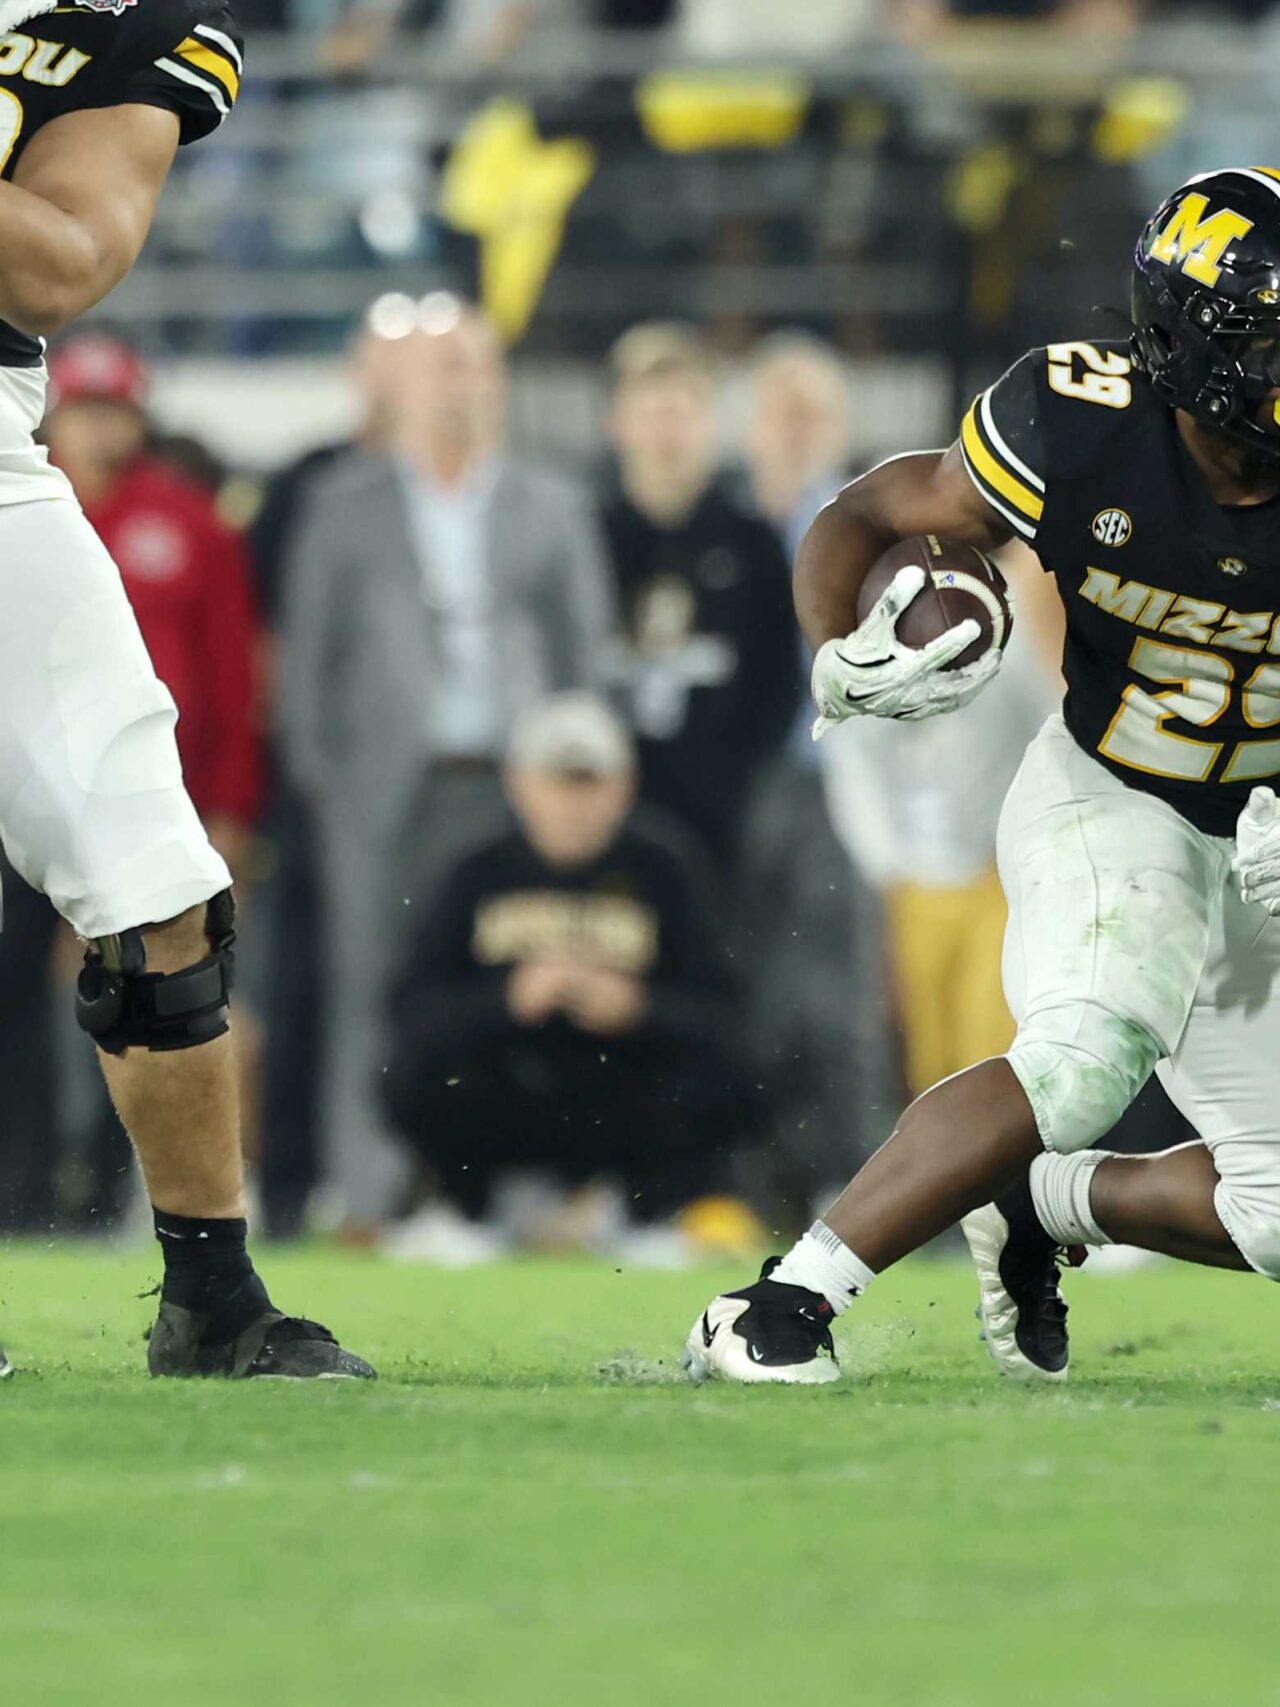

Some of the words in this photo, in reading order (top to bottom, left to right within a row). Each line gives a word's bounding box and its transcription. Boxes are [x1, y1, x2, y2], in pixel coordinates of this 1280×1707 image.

[1149, 191, 1256, 289] M
[1047, 341, 1132, 409] 29
[1094, 510, 1130, 545] SEC
